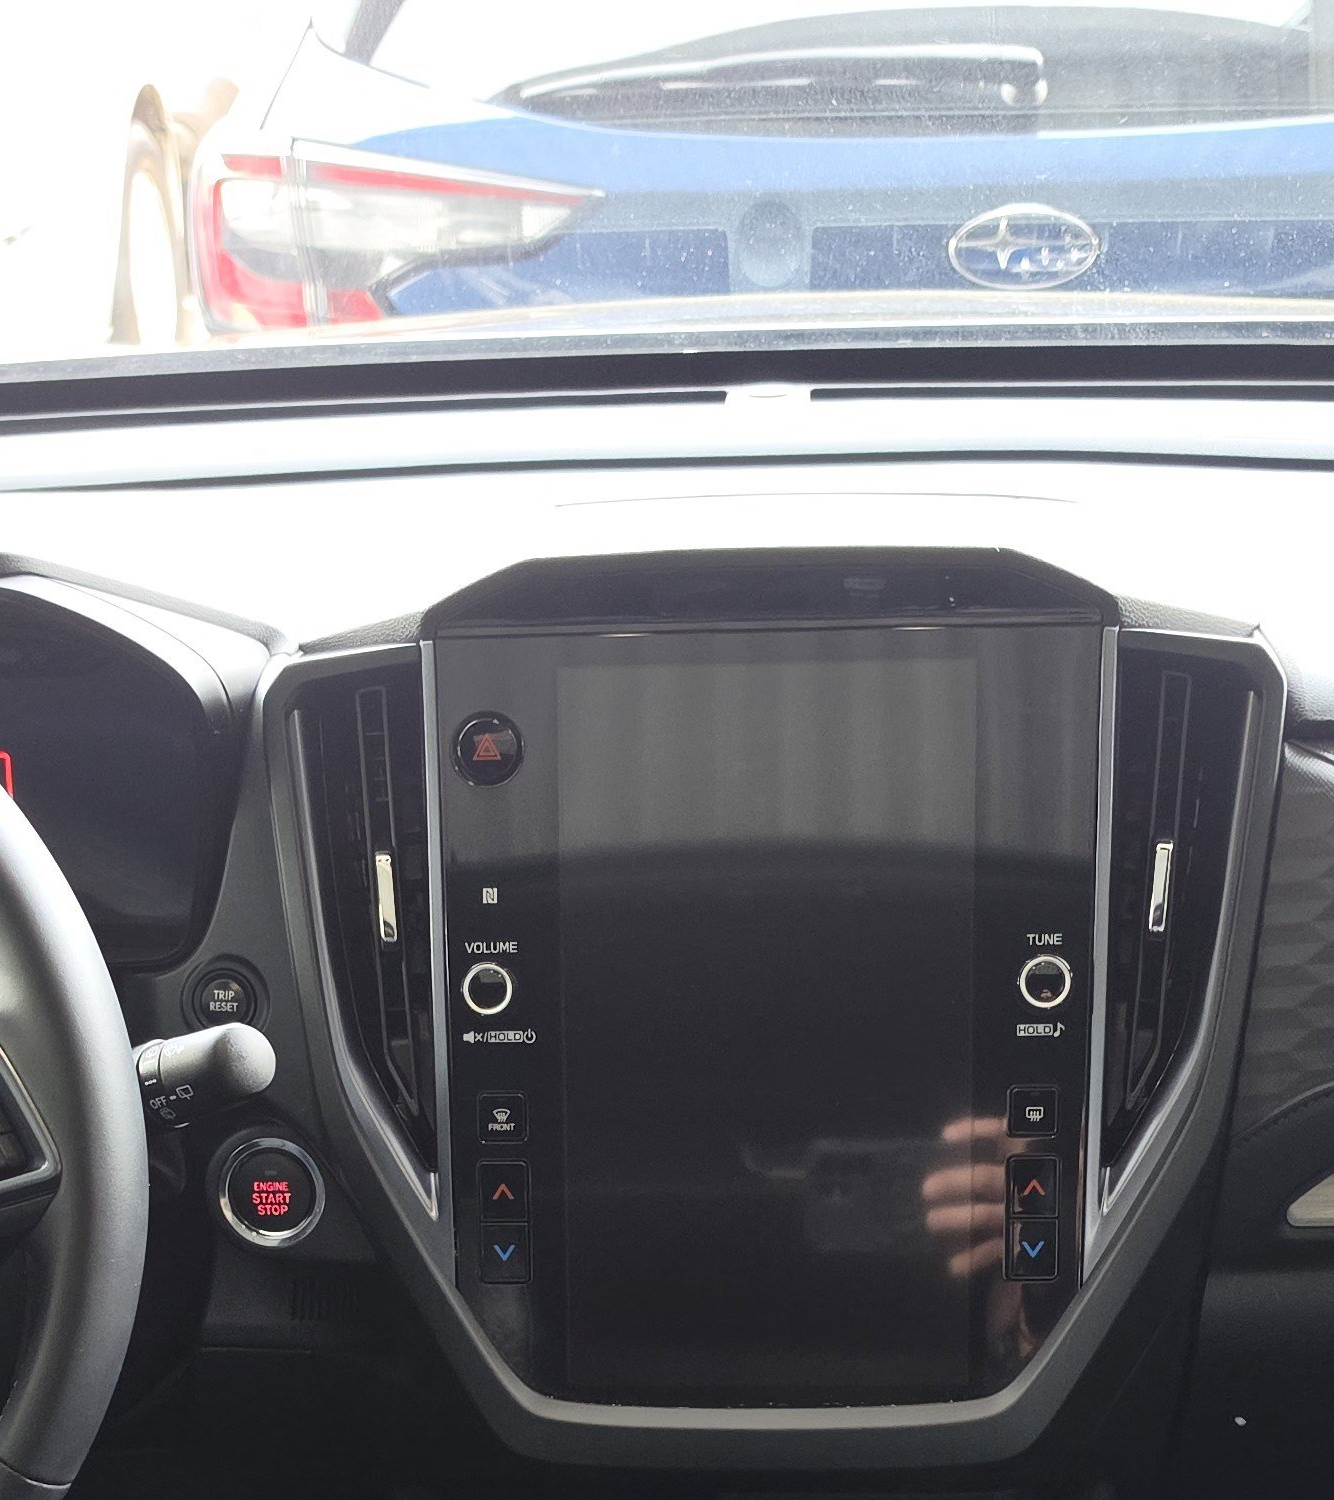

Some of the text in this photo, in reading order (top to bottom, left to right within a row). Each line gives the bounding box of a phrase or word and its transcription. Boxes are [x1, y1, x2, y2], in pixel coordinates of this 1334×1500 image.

[1026, 933, 1063, 946] TUNE
[465, 941, 518, 954] VOLUME
[213, 989, 235, 1001] TRIP
[209, 1001, 238, 1012] RESET
[1018, 1025, 1052, 1035] HOLD
[489, 1031, 522, 1042] HOLD
[149, 1095, 167, 1110] OFF
[488, 1123, 516, 1131] FRONT
[253, 1181, 289, 1192] ENGINE
[252, 1193, 291, 1204] START
[257, 1204, 289, 1216] STOP
